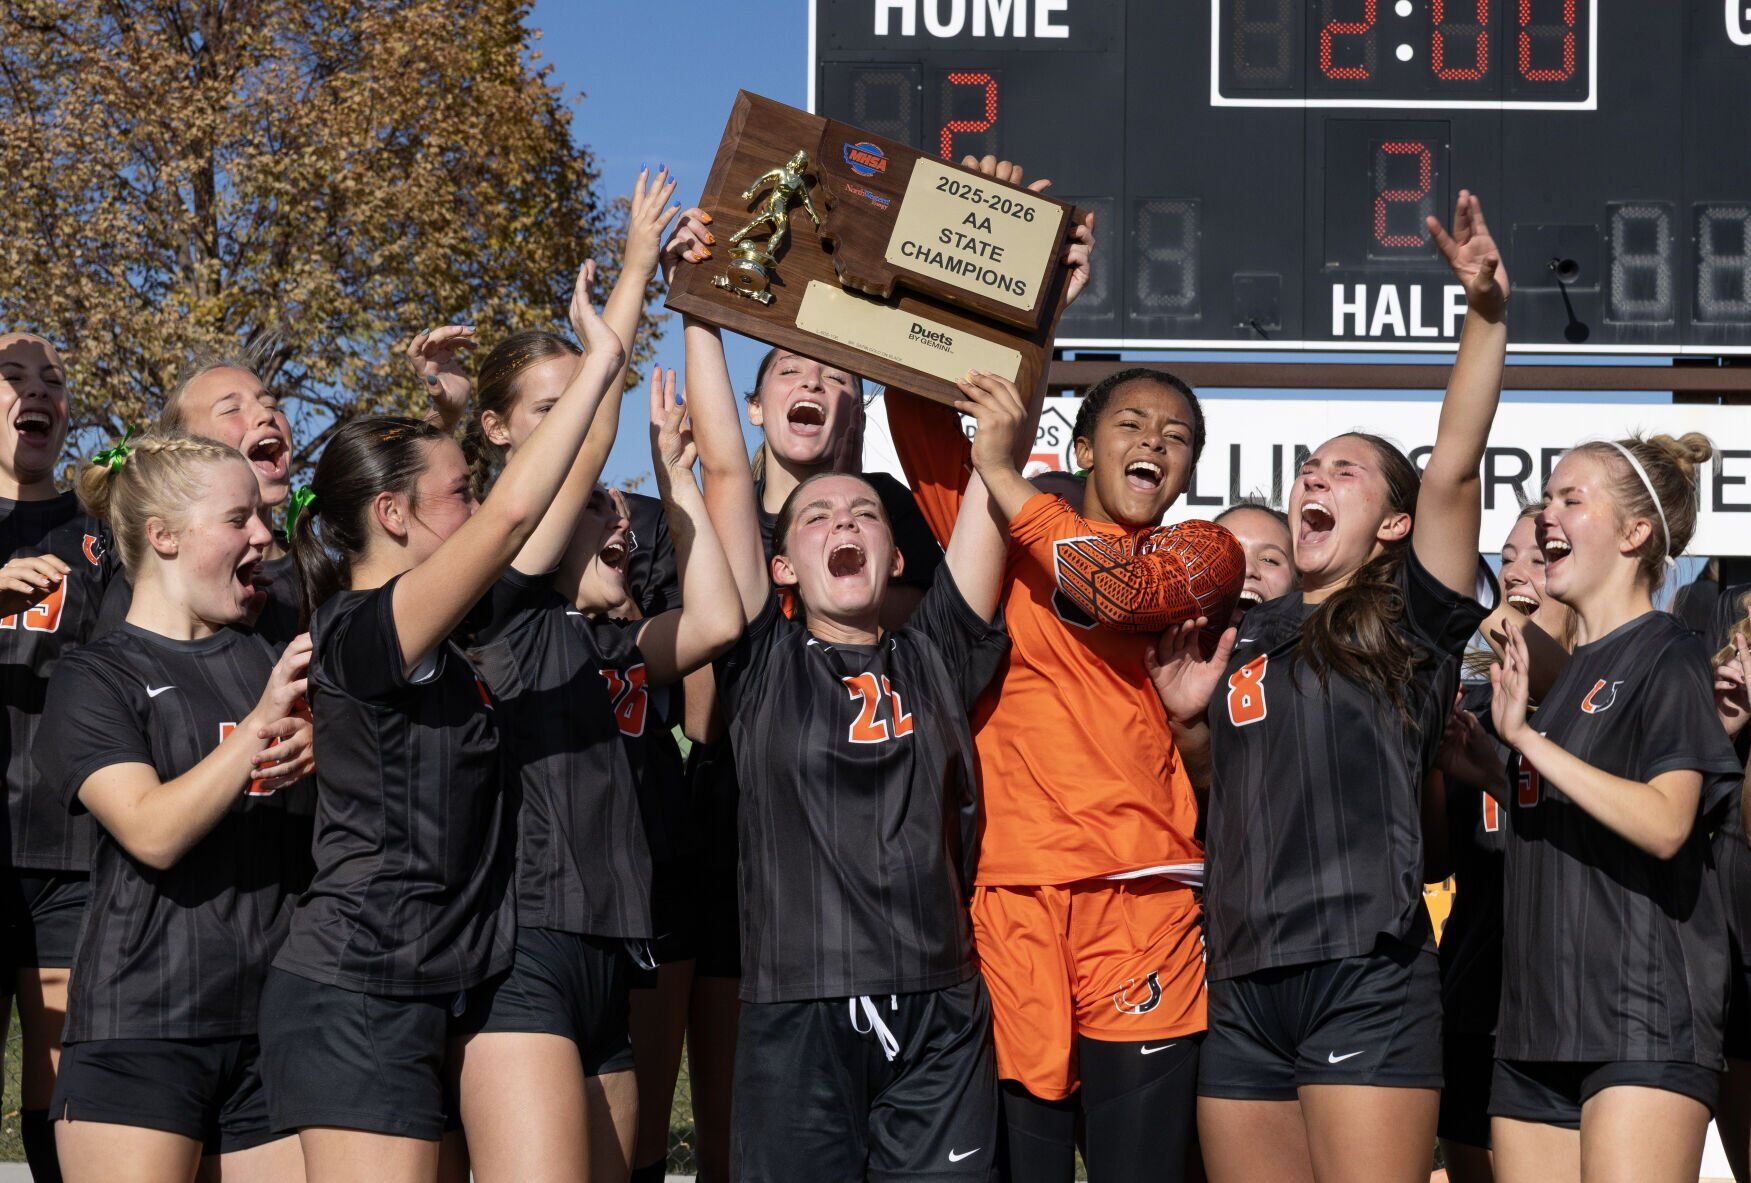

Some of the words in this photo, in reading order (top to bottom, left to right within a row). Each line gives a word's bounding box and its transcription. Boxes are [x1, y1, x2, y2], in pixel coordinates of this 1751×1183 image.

[874, 0, 1069, 38] HOME
[848, 148, 888, 172] MHSA
[936, 176, 1036, 222] 2025-2026
[1374, 142, 1431, 247] 2
[962, 212, 993, 234] AA
[938, 228, 1005, 263] STATE
[900, 240, 1027, 296] CHAMPIONS
[1332, 283, 1469, 337] HALF
[908, 333, 921, 341] BY
[910, 322, 953, 346] Duets
[1227, 653, 1268, 727] 8
